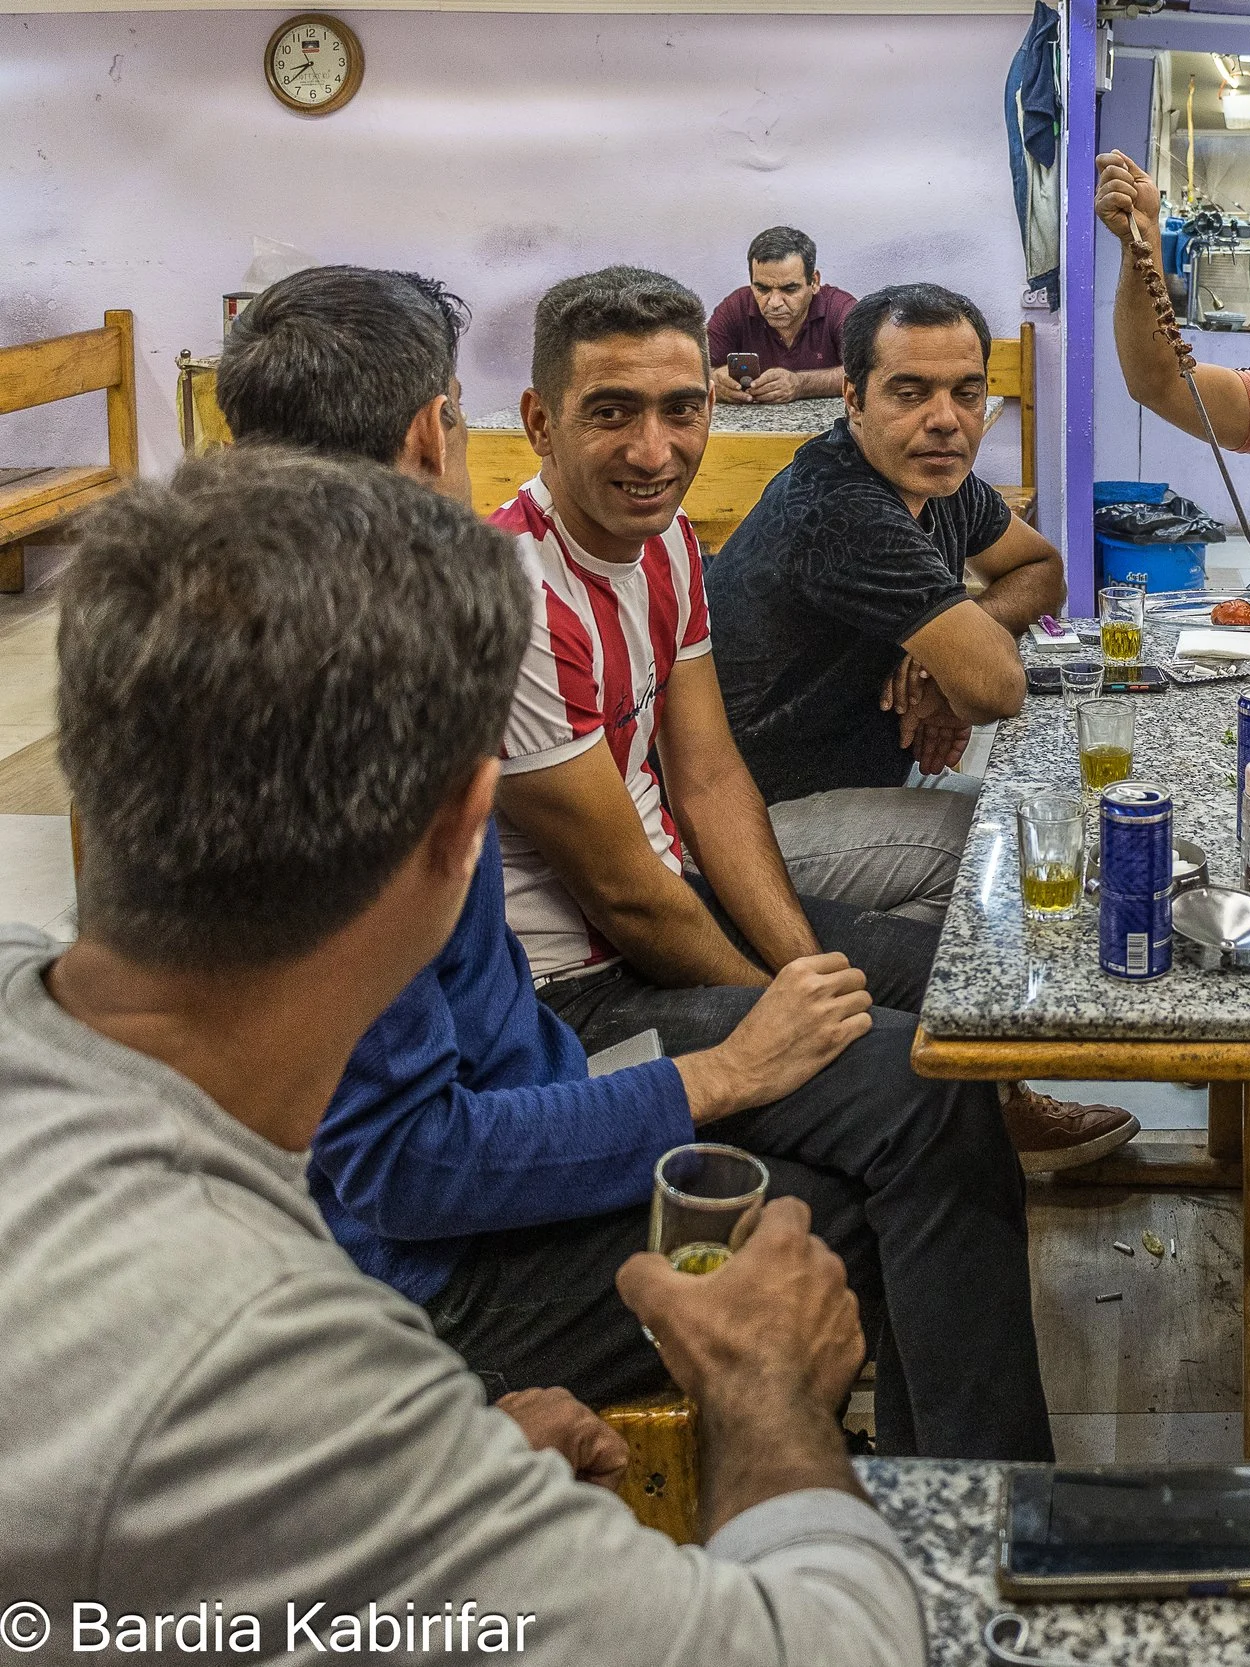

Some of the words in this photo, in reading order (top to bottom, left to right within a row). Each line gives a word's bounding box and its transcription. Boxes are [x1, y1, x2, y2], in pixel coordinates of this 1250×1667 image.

[292, 33, 300, 43] 11
[306, 28, 316, 38] 12
[323, 31, 327, 40] 1
[281, 45, 292, 55] 10
[332, 41, 340, 51] 2
[278, 60, 285, 70] 9
[338, 57, 346, 67] 3
[283, 75, 290, 85] 8
[334, 74, 341, 83] 4
[294, 86, 302, 96] 7
[309, 89, 317, 99] 6
[324, 84, 332, 94] 5
